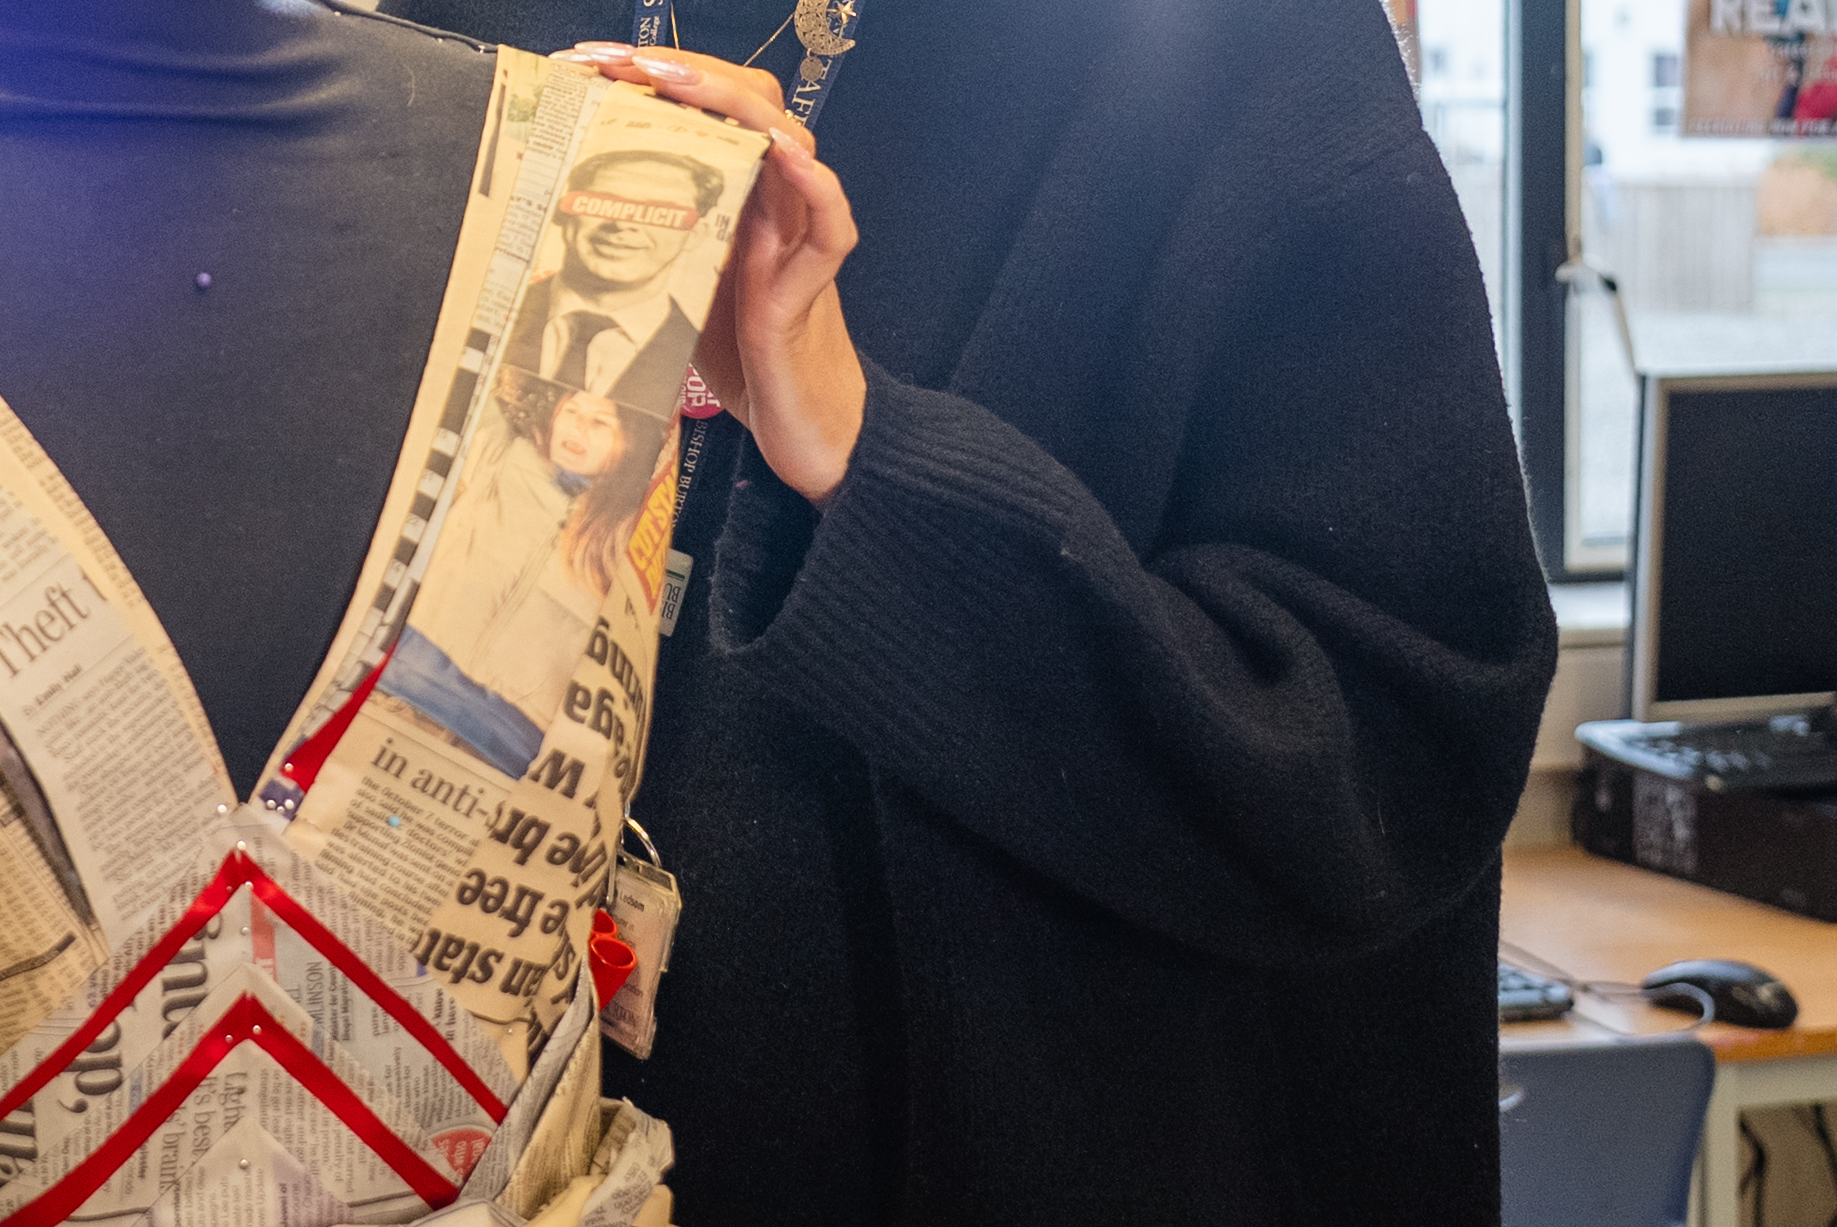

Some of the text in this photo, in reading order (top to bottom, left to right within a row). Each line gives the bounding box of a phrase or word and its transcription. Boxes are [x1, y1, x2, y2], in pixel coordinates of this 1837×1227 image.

[572, 194, 689, 230] COMPLICIT
[684, 420, 709, 473] BISHOP
[371, 735, 409, 778] in
[380, 786, 424, 817] October
[433, 815, 470, 842] terror
[346, 849, 388, 878] alerted
[348, 836, 393, 868] training
[389, 859, 428, 887] course
[398, 837, 438, 865] Zionist
[455, 867, 545, 939] free
[193, 1111, 218, 1158] best
